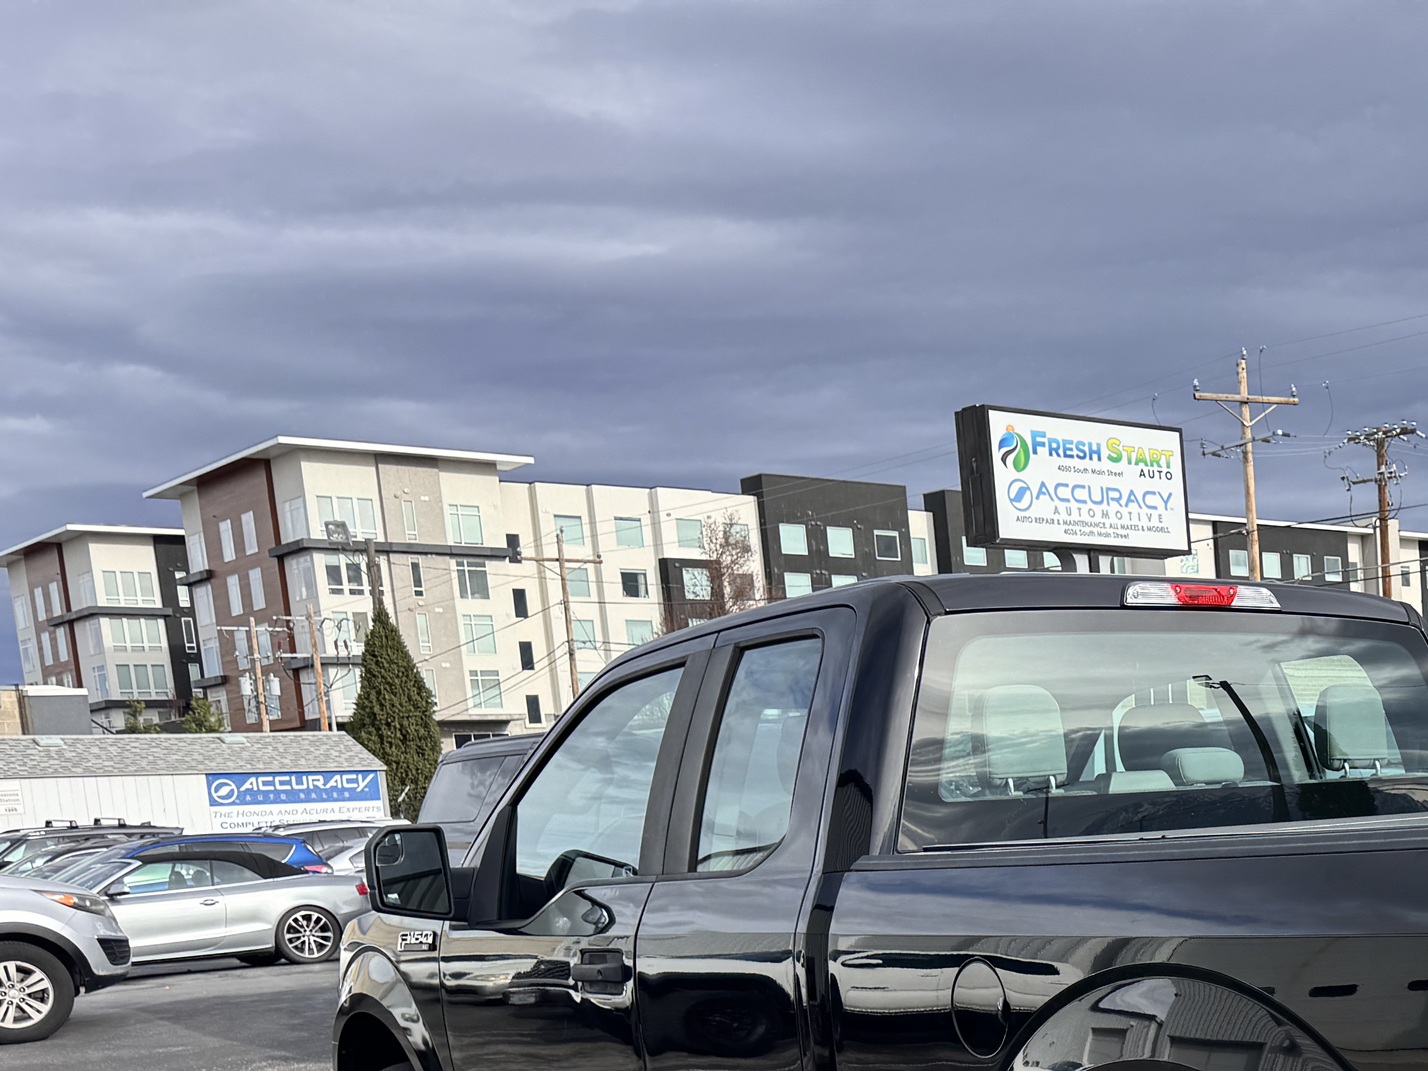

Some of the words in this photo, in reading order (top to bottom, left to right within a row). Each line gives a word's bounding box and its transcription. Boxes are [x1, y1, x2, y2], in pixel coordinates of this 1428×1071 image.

[1031, 430, 1102, 462] FRESH
[1106, 437, 1174, 469] START
[1057, 465, 1072, 473] 4050
[1073, 466, 1089, 474] South
[1091, 468, 1106, 476] Main
[1107, 469, 1124, 478] Street
[1139, 468, 1173, 481] AUTO
[1035, 481, 1173, 511] ACCURACY
[1053, 505, 1163, 523] AUTOMOTIVE
[1016, 516, 1033, 524] AUTO
[1034, 517, 1055, 525] REPAIR
[1109, 522, 1119, 530] ALL
[1121, 523, 1140, 532] MAKES
[1079, 529, 1096, 538] South
[1097, 530, 1112, 539] Main
[1113, 531, 1129, 540] Street
[239, 773, 375, 792] ACCURACY
[246, 793, 287, 801] AUTO
[299, 791, 350, 800] SALES
[212, 810, 234, 819] THE
[236, 809, 274, 818] HONDA
[276, 809, 298, 817] AND
[300, 807, 336, 815] ACURA
[338, 805, 382, 814] EXPERTS
